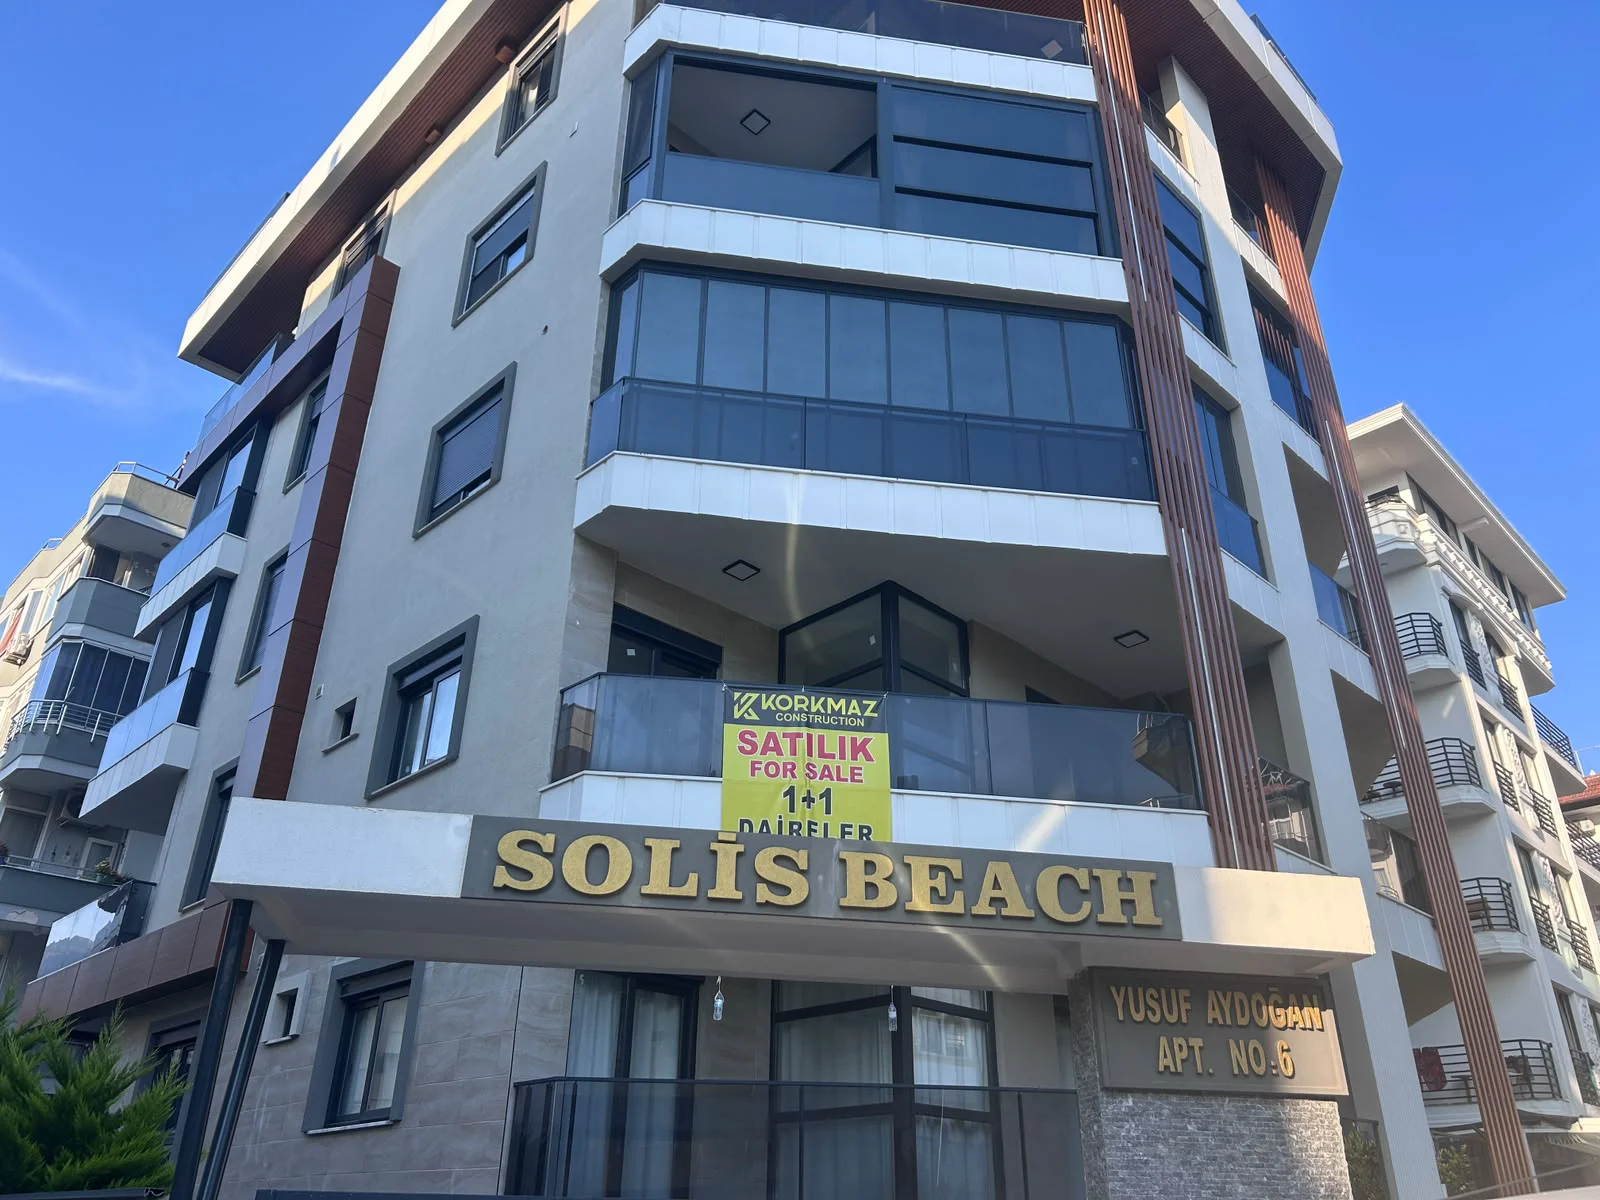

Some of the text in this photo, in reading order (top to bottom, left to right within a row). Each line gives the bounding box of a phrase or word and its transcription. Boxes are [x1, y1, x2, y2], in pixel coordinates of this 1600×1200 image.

[761, 693, 878, 717] KORKMAZ
[775, 712, 865, 727] CONSTRUCTION
[737, 729, 875, 763] SATILIK
[750, 760, 864, 784] FOR SALE
[782, 785, 833, 815] 1+1
[493, 829, 1163, 926] SOLİS BEACH
[1109, 985, 1324, 1031] YUSUF AYDOĞAN
[1158, 1035, 1215, 1075] APT.
